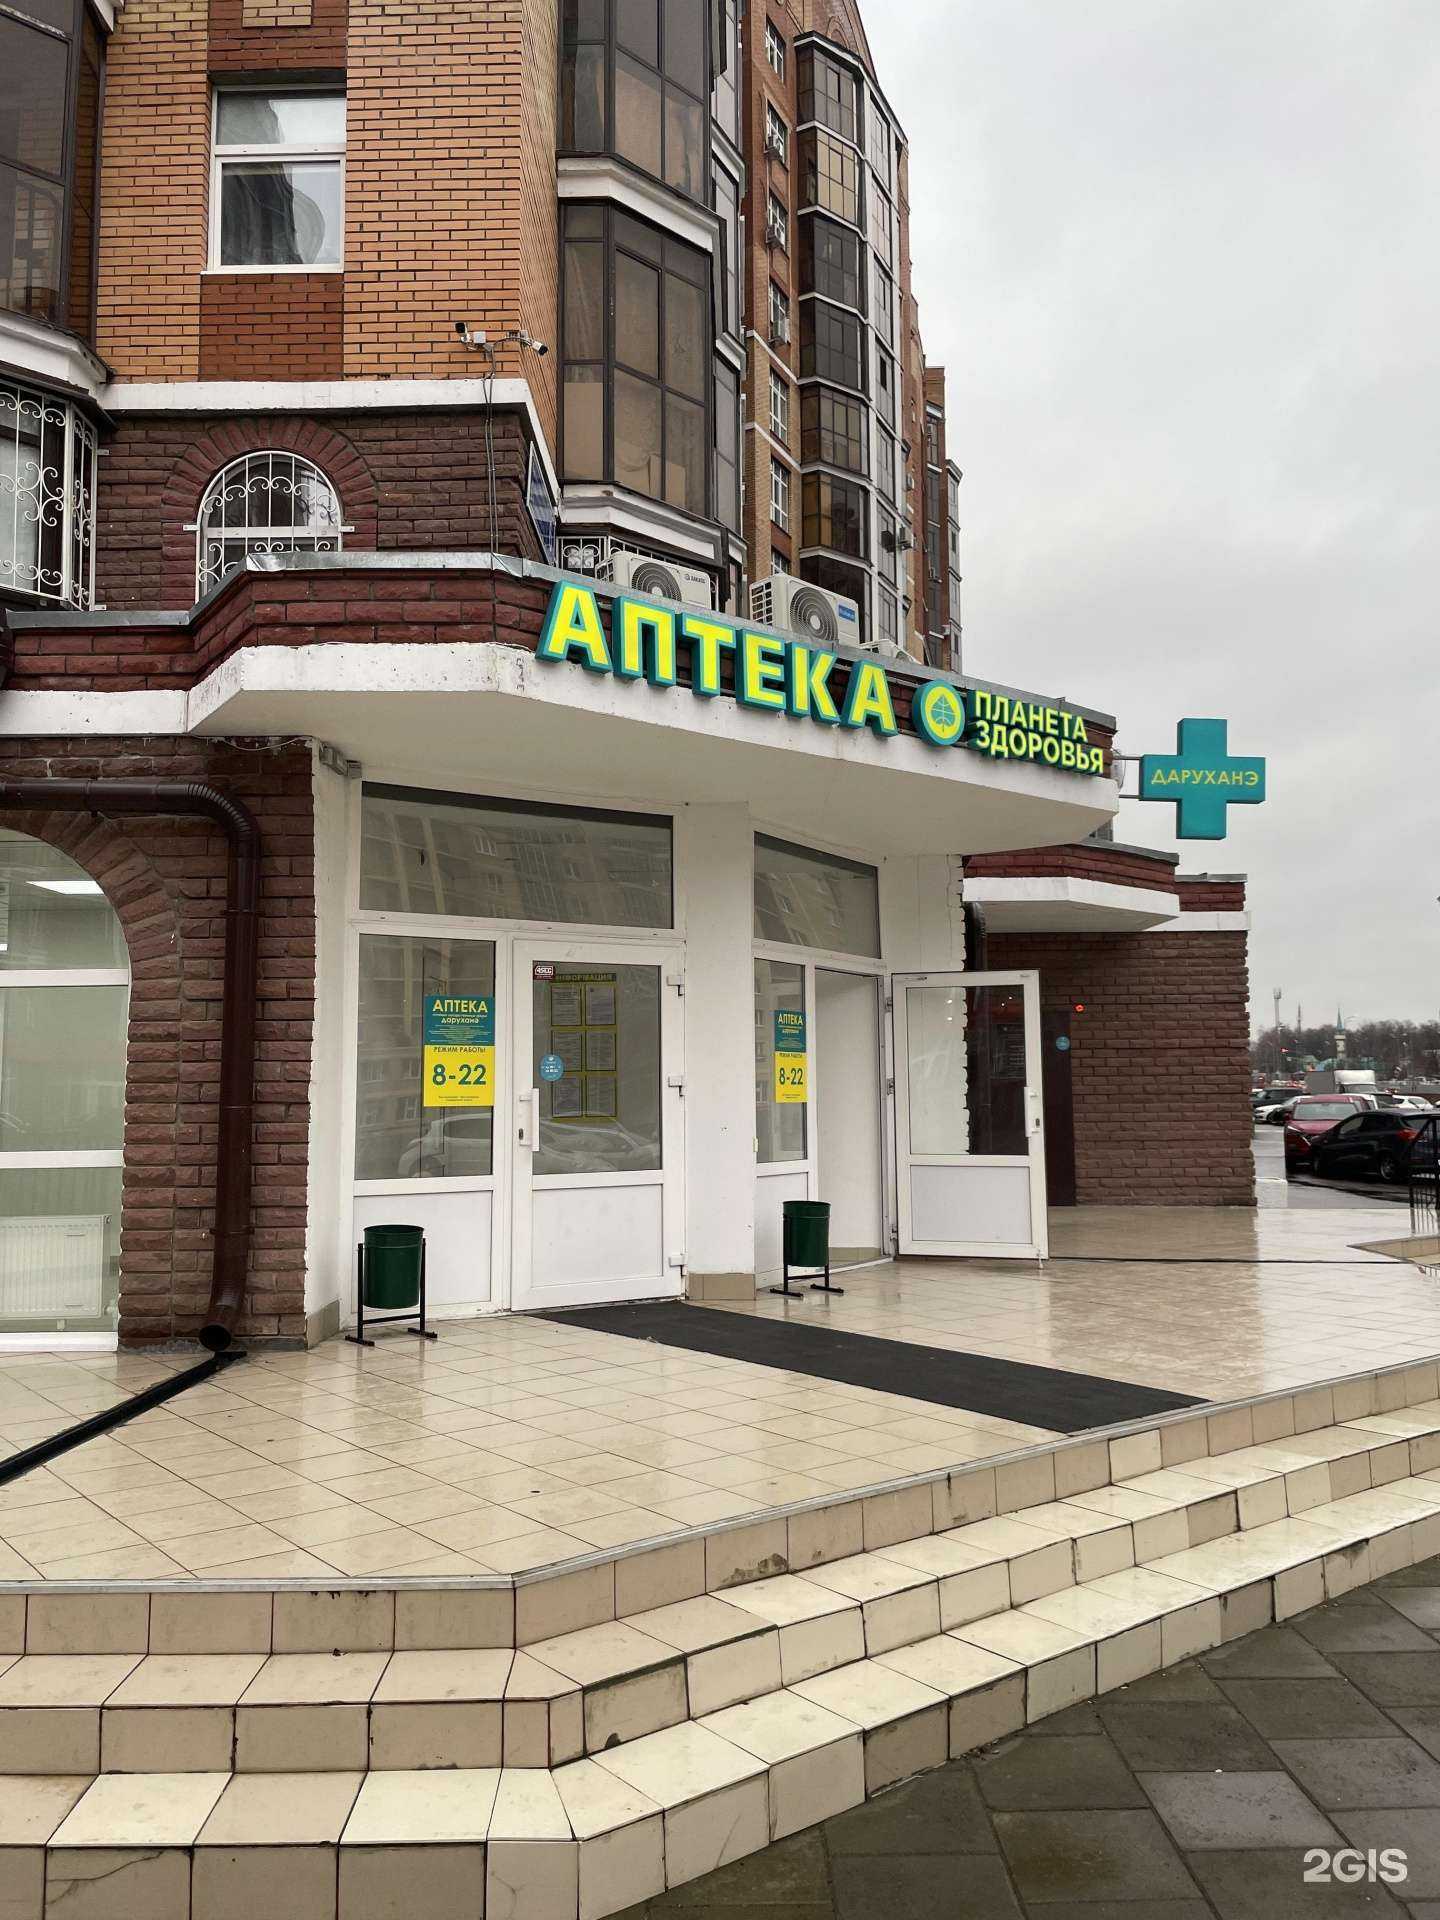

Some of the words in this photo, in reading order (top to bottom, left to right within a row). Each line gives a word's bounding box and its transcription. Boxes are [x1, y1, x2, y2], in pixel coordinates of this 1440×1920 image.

[536, 579, 895, 735] АПТЕКА
[975, 690, 1088, 743] ПЛАНЕТА
[976, 720, 1104, 774] ЗДОРОВЬЯ
[1151, 769, 1259, 786] ДАРУХАНЭ
[432, 999, 488, 1013] АПТЕКА
[778, 1013, 803, 1025] АПТЕКА
[432, 1063, 487, 1085] 8-22
